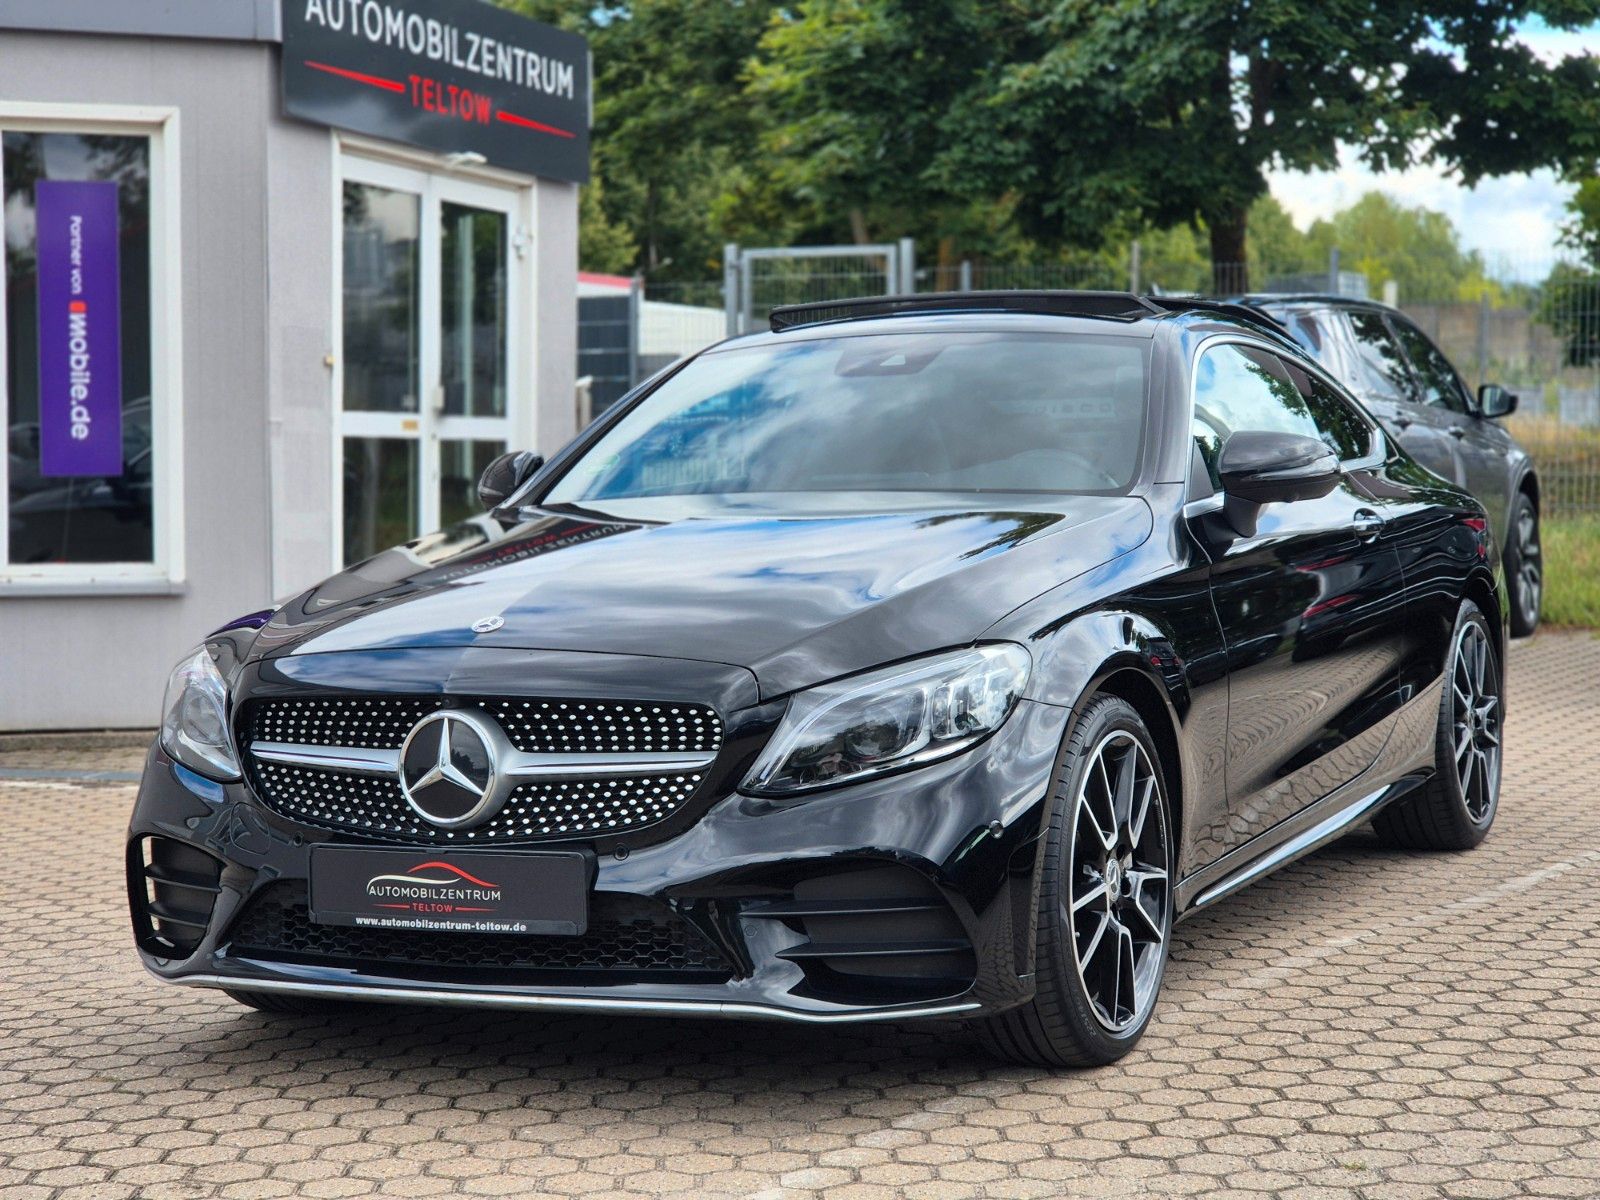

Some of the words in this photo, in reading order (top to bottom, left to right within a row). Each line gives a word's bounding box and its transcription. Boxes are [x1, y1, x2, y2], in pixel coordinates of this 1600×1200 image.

[305, 0, 573, 99] AUTOMOBILZENTRUM
[409, 75, 491, 124] TELTOW
[70, 215, 82, 265] Partner
[71, 268, 82, 294] von
[369, 886, 500, 900] AUTOMOBILZENTRUM
[412, 903, 453, 912] TELTOW
[356, 917, 527, 931] www.automobilzentrum-teltow.de
